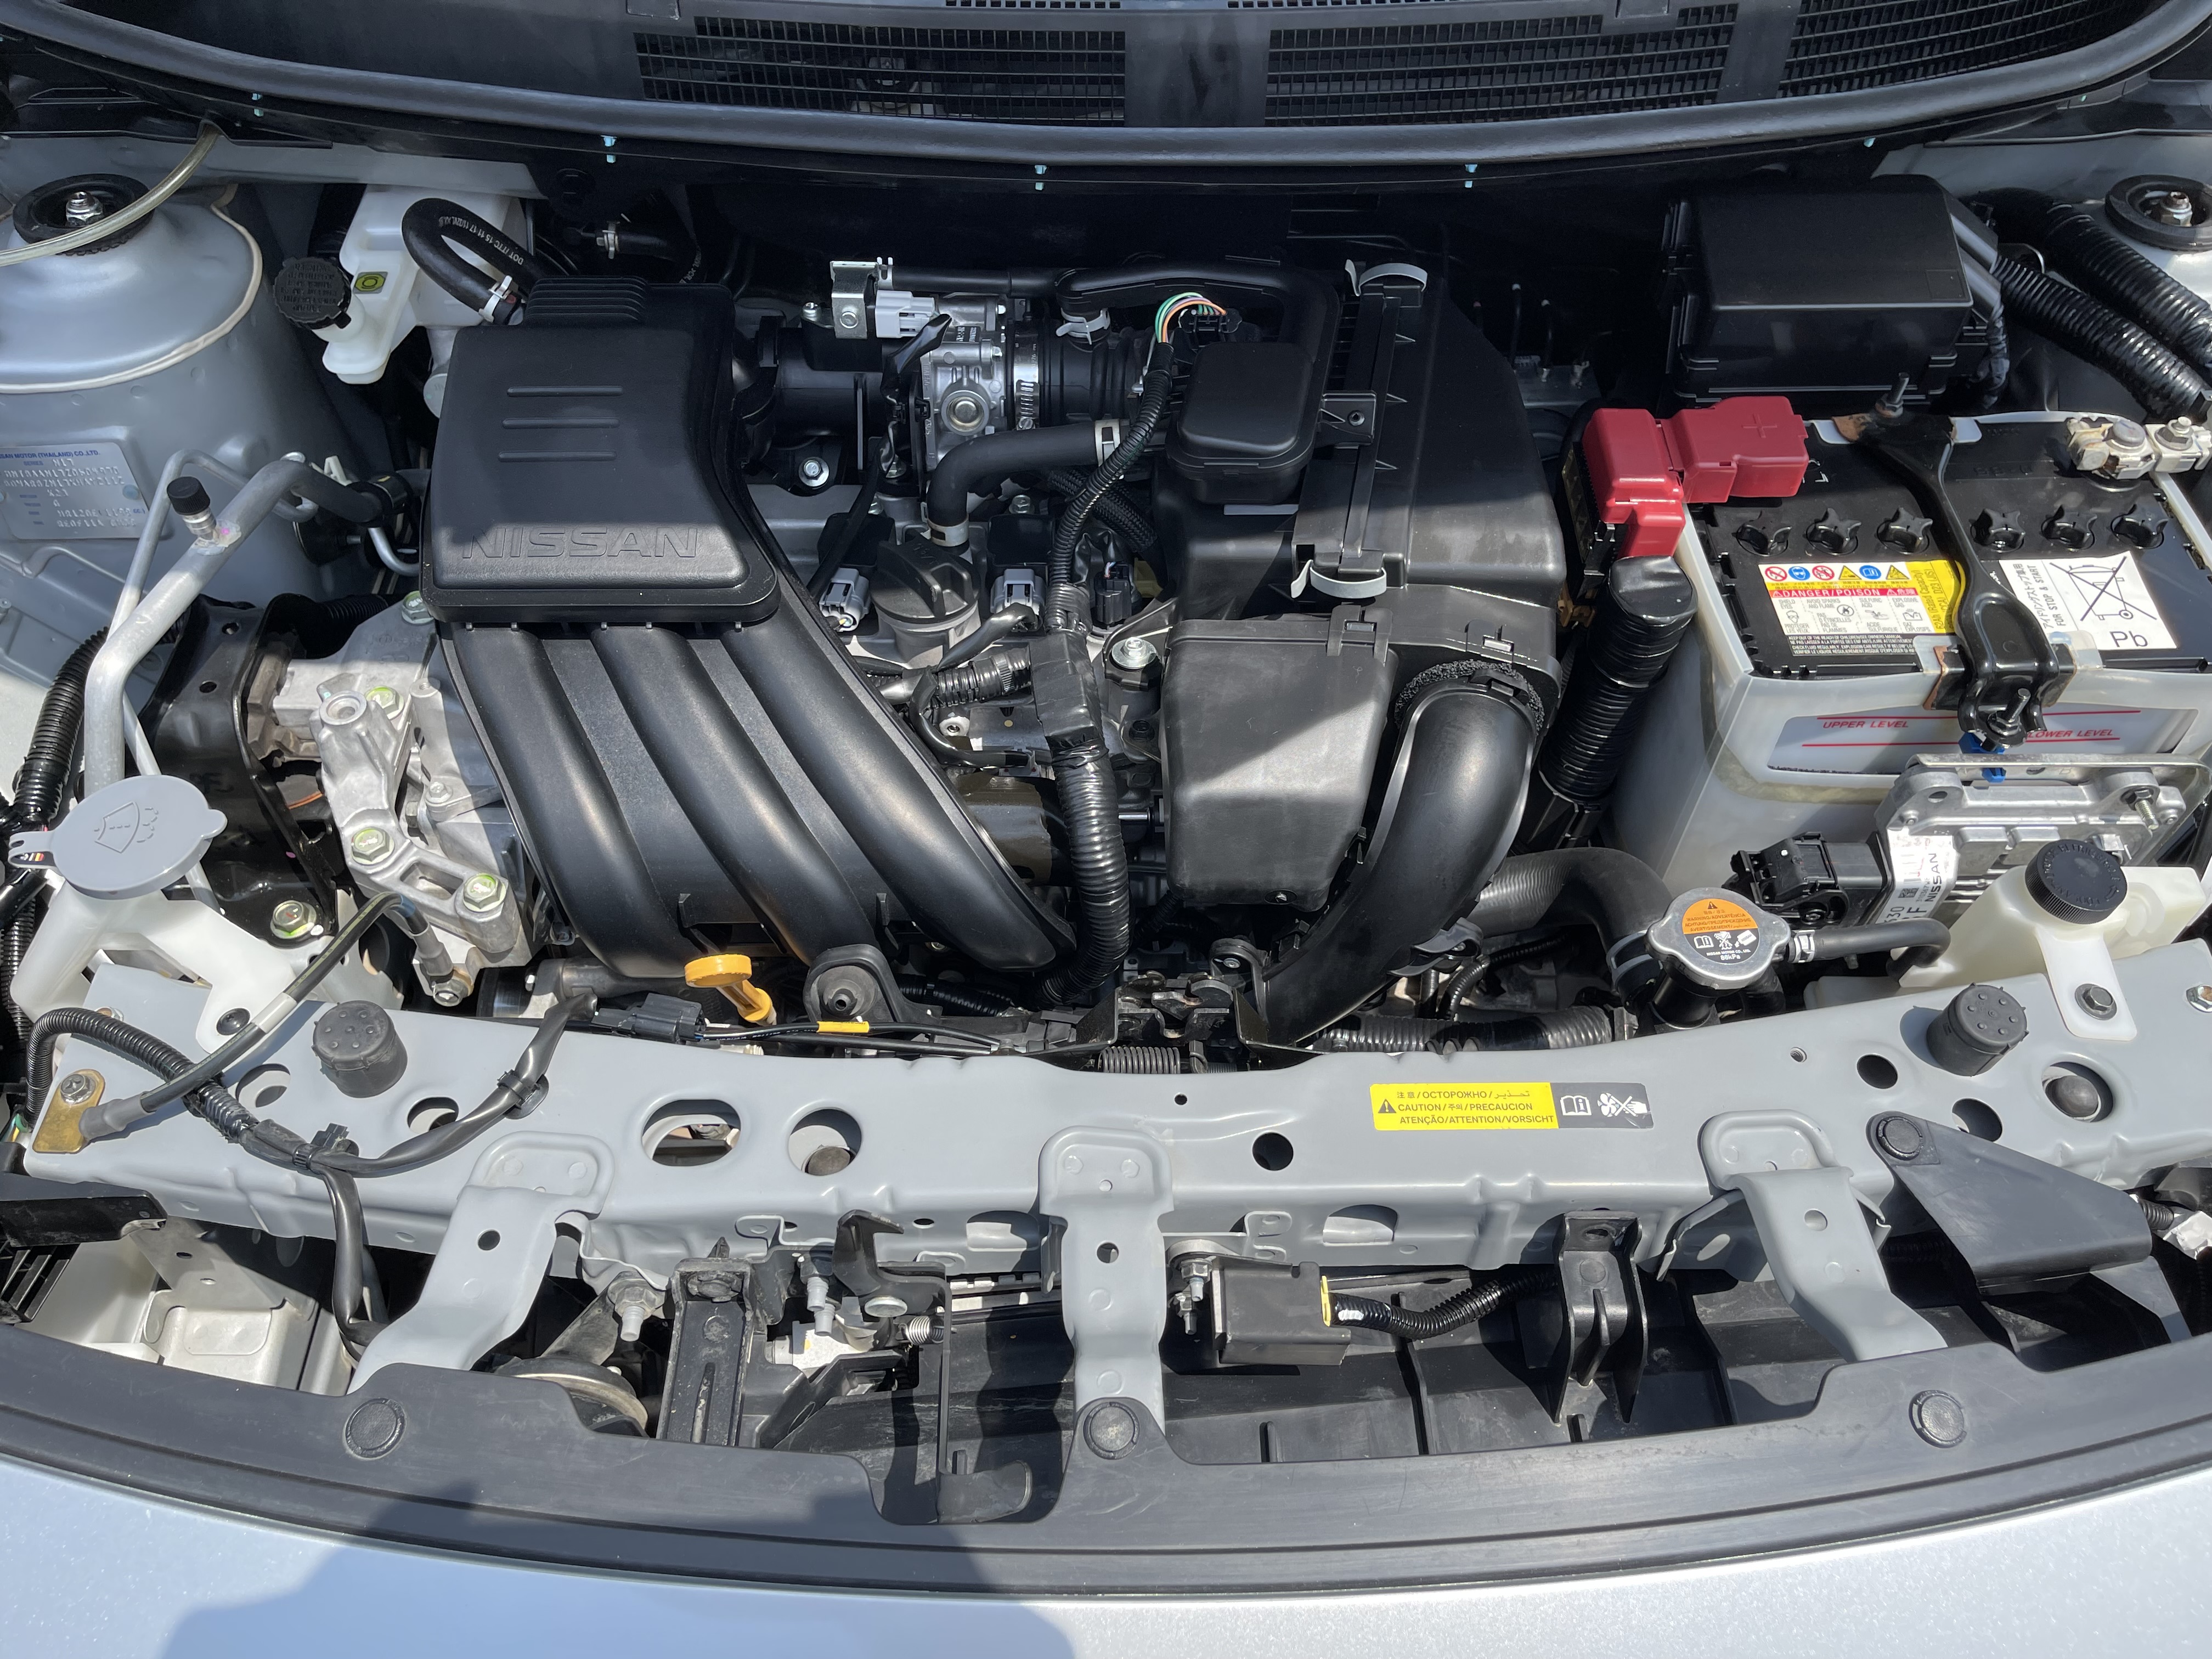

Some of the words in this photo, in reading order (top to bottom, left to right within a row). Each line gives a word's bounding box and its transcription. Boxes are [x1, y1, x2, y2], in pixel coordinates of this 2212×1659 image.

[469, 224, 477, 233] 17
[485, 234, 494, 244] 15
[509, 251, 524, 265] DOT
[53, 458, 74, 467] N17
[462, 527, 697, 558] NISSAN
[2028, 565, 2045, 584] START
[1911, 570, 1930, 594] Capacity)
[1783, 589, 1880, 597] DANGER/POISON
[2044, 593, 2058, 612] STOP
[2052, 614, 2066, 627] FOR
[2110, 631, 2148, 647] Pb
[1822, 720, 1864, 729] UPPER
[1870, 720, 1909, 729] LEVEL
[2027, 730, 2072, 738] LOWER
[2077, 729, 2113, 737] LEVEL
[1925, 853, 1942, 902] NISSAN
[1470, 1103, 1533, 1111] PRECAUCION
